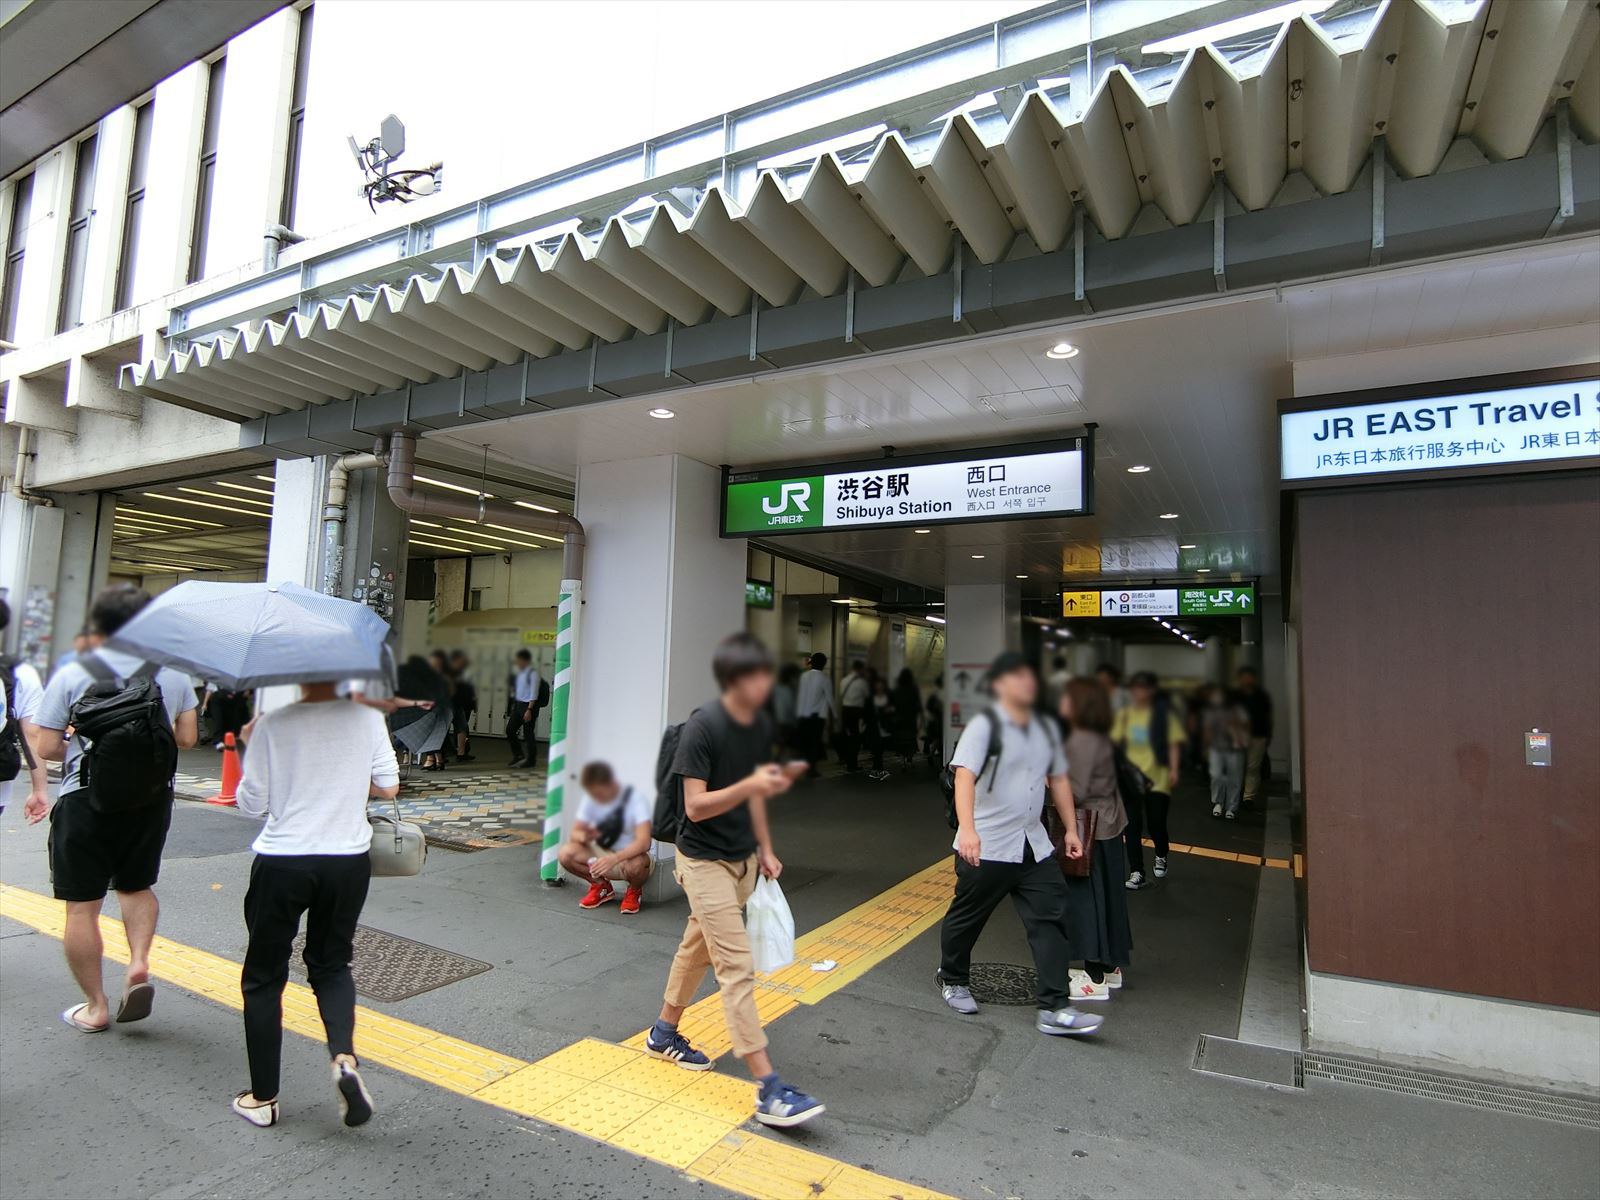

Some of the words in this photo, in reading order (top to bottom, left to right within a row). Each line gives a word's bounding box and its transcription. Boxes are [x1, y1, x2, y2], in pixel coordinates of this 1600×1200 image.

[1313, 416, 1354, 441] JR
[1367, 405, 1458, 436] EAST
[1469, 392, 1581, 426] Travel
[1316, 437, 1505, 469] JR东日本旅行服务中心
[967, 464, 1006, 485] 西口
[761, 481, 811, 514] JR
[837, 473, 910, 501] 渋谷駅
[967, 487, 995, 498] West
[999, 484, 1051, 496] Entrance
[836, 505, 894, 520] Shibuya
[898, 499, 952, 515] Station
[967, 501, 995, 512] 西入口
[1003, 498, 1023, 509] 서쪽
[1026, 496, 1047, 508] 입구
[768, 513, 804, 526] JR東日本
[1209, 590, 1234, 603] JR
